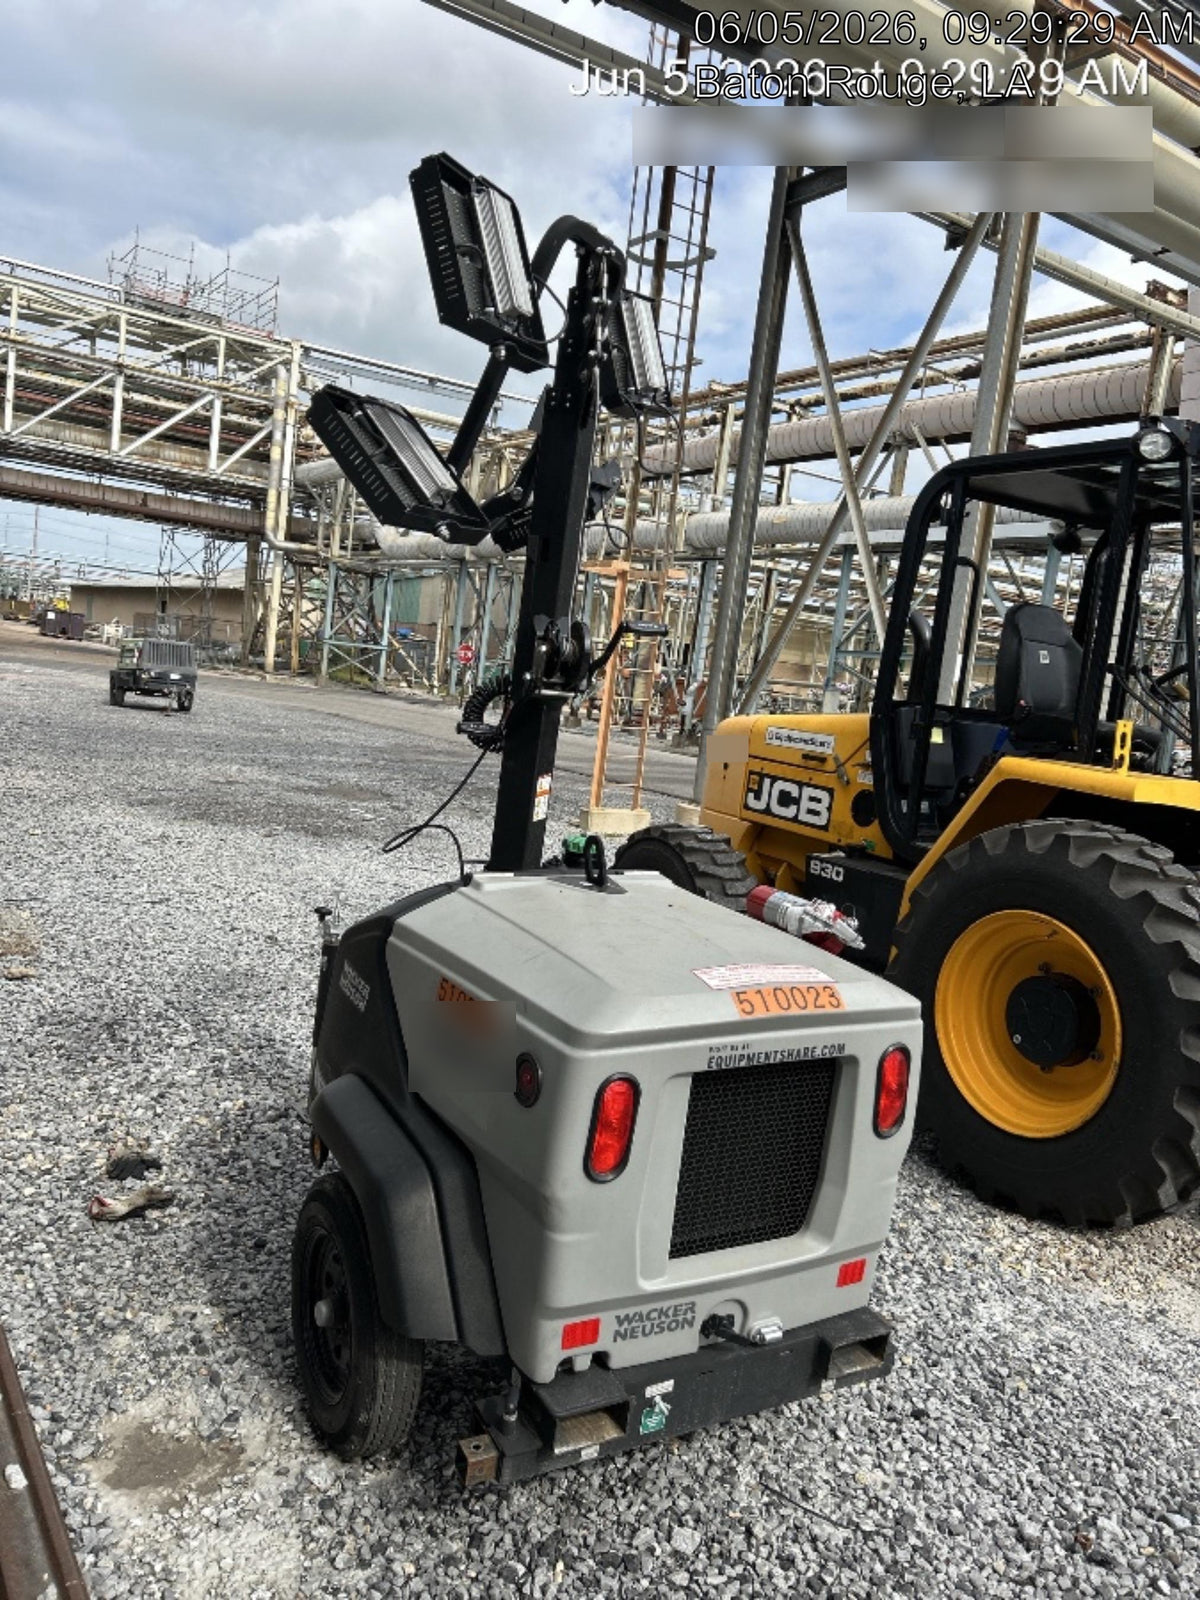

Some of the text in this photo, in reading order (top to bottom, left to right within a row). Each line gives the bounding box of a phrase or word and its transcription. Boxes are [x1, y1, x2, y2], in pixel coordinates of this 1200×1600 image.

[746, 777, 831, 826] JCB
[810, 860, 844, 882] 930
[735, 985, 841, 1016] 510023
[707, 1043, 846, 1070] EQUIPMENTSHARE.COM
[615, 1301, 696, 1327] WACKER
[613, 1315, 696, 1343] NEUSON
